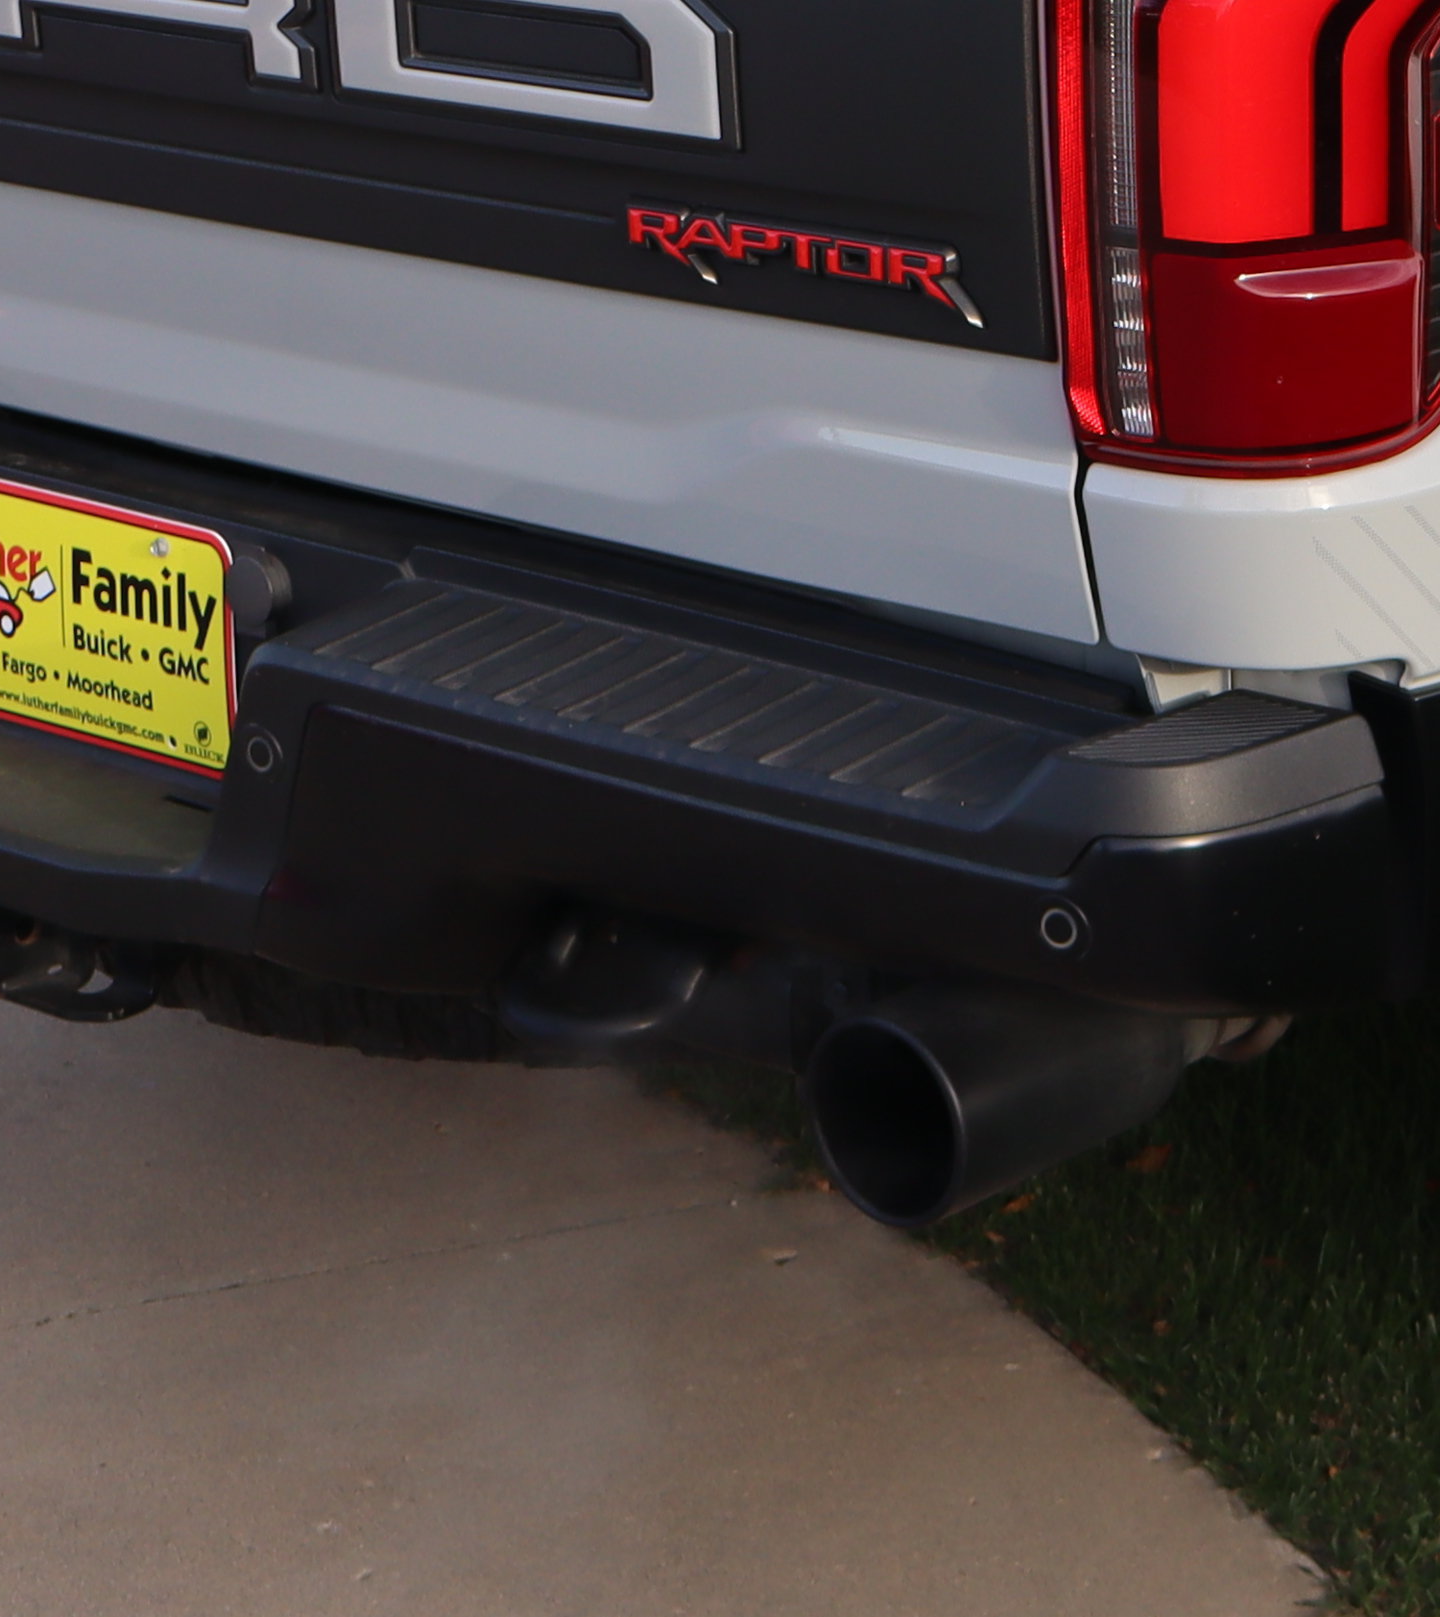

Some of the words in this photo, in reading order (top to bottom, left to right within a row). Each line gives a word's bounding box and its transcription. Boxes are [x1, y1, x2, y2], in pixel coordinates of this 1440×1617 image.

[625, 197, 985, 329] RAPTOR
[71, 547, 217, 650] Family
[1, 651, 48, 683] Fargo
[66, 670, 154, 711] Moorhead
[72, 624, 133, 664] Buick
[159, 647, 210, 685] GMC
[183, 743, 226, 764] BUICK
